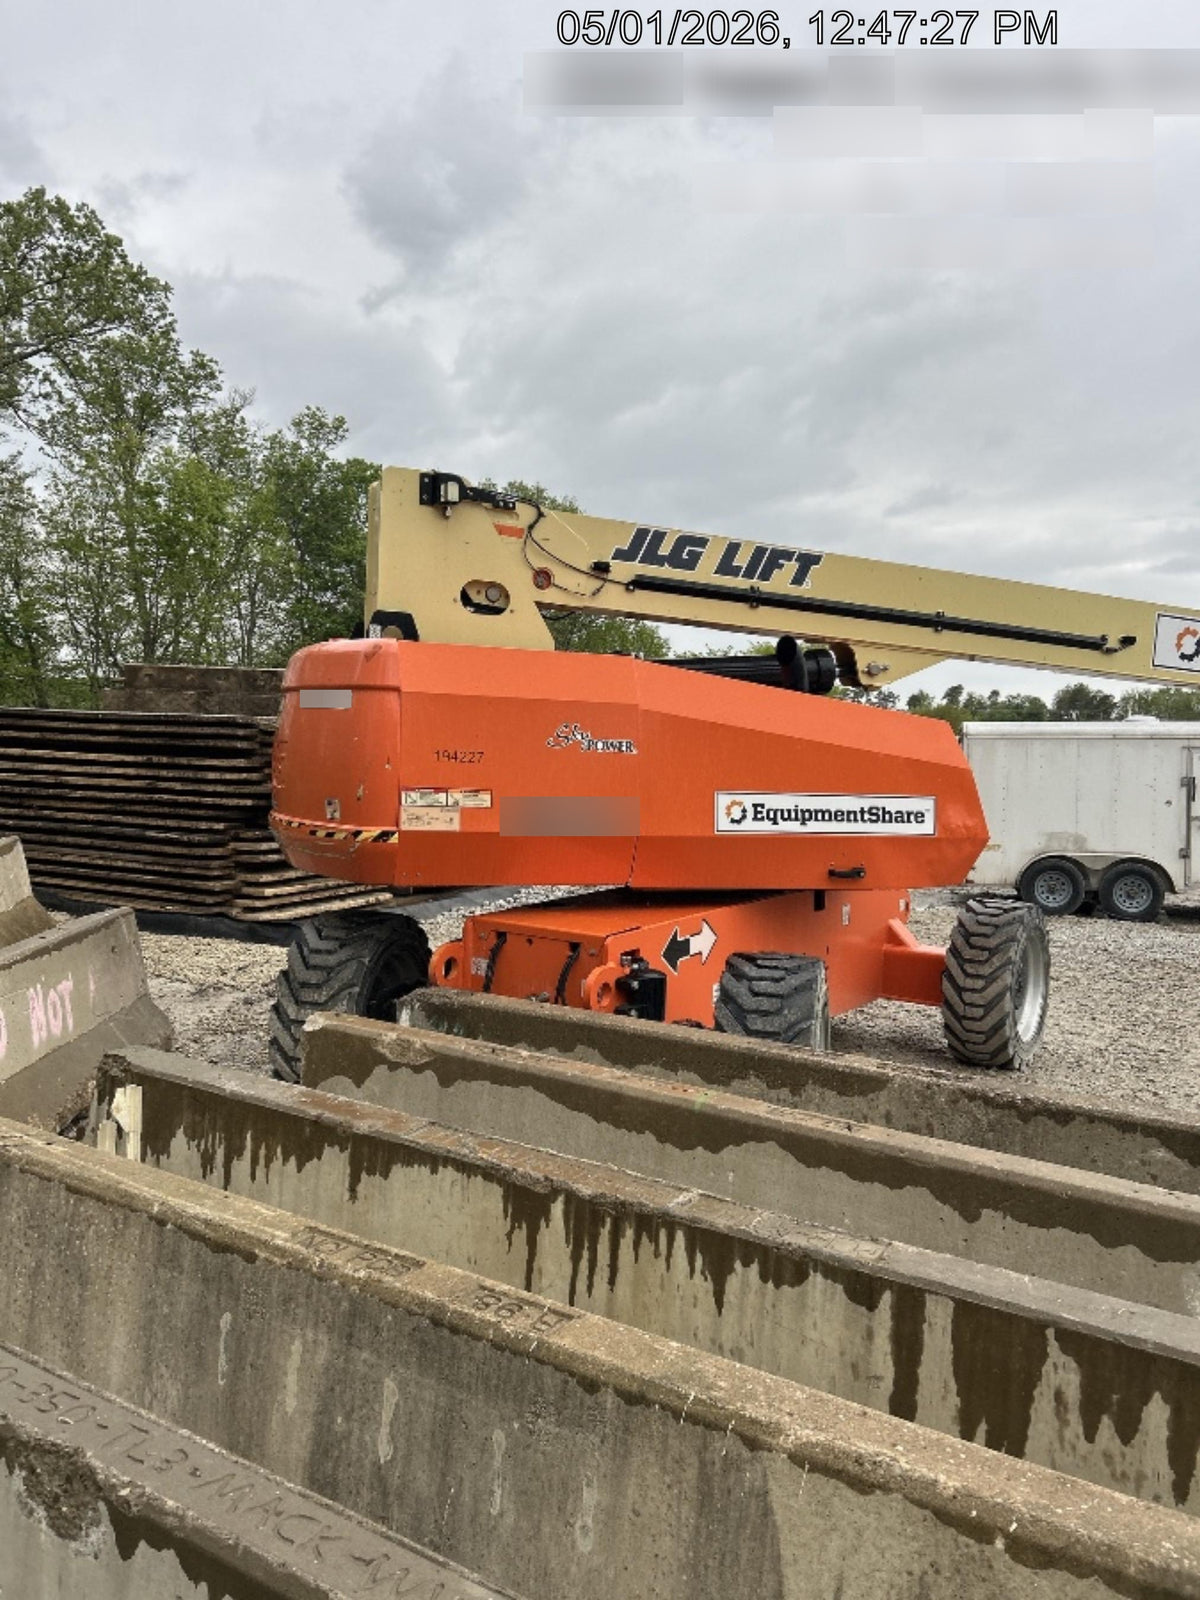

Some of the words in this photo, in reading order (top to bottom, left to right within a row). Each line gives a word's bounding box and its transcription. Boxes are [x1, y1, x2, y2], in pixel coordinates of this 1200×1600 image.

[611, 526, 712, 572] JLG
[712, 539, 825, 588] LIFT
[434, 750, 484, 763] 194227
[751, 803, 926, 825] EquipmentShare
[28, 972, 74, 1050] NOT
